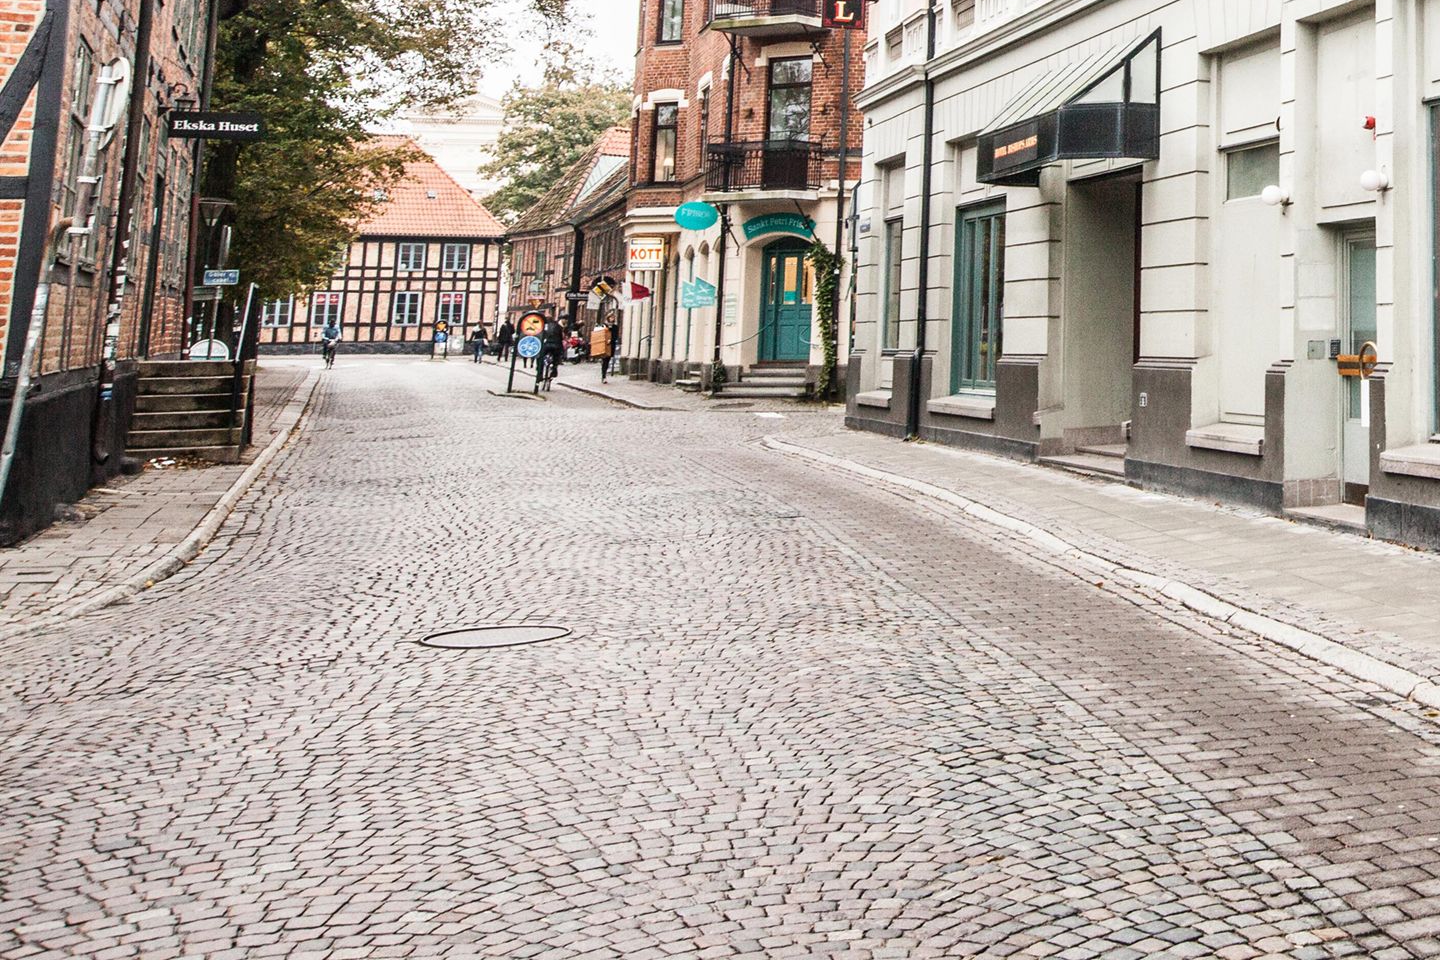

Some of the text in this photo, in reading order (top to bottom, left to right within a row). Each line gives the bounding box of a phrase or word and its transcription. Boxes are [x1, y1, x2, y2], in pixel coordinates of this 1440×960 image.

[173, 120, 259, 132] Ekska Huset
[769, 217, 788, 226] Petri
